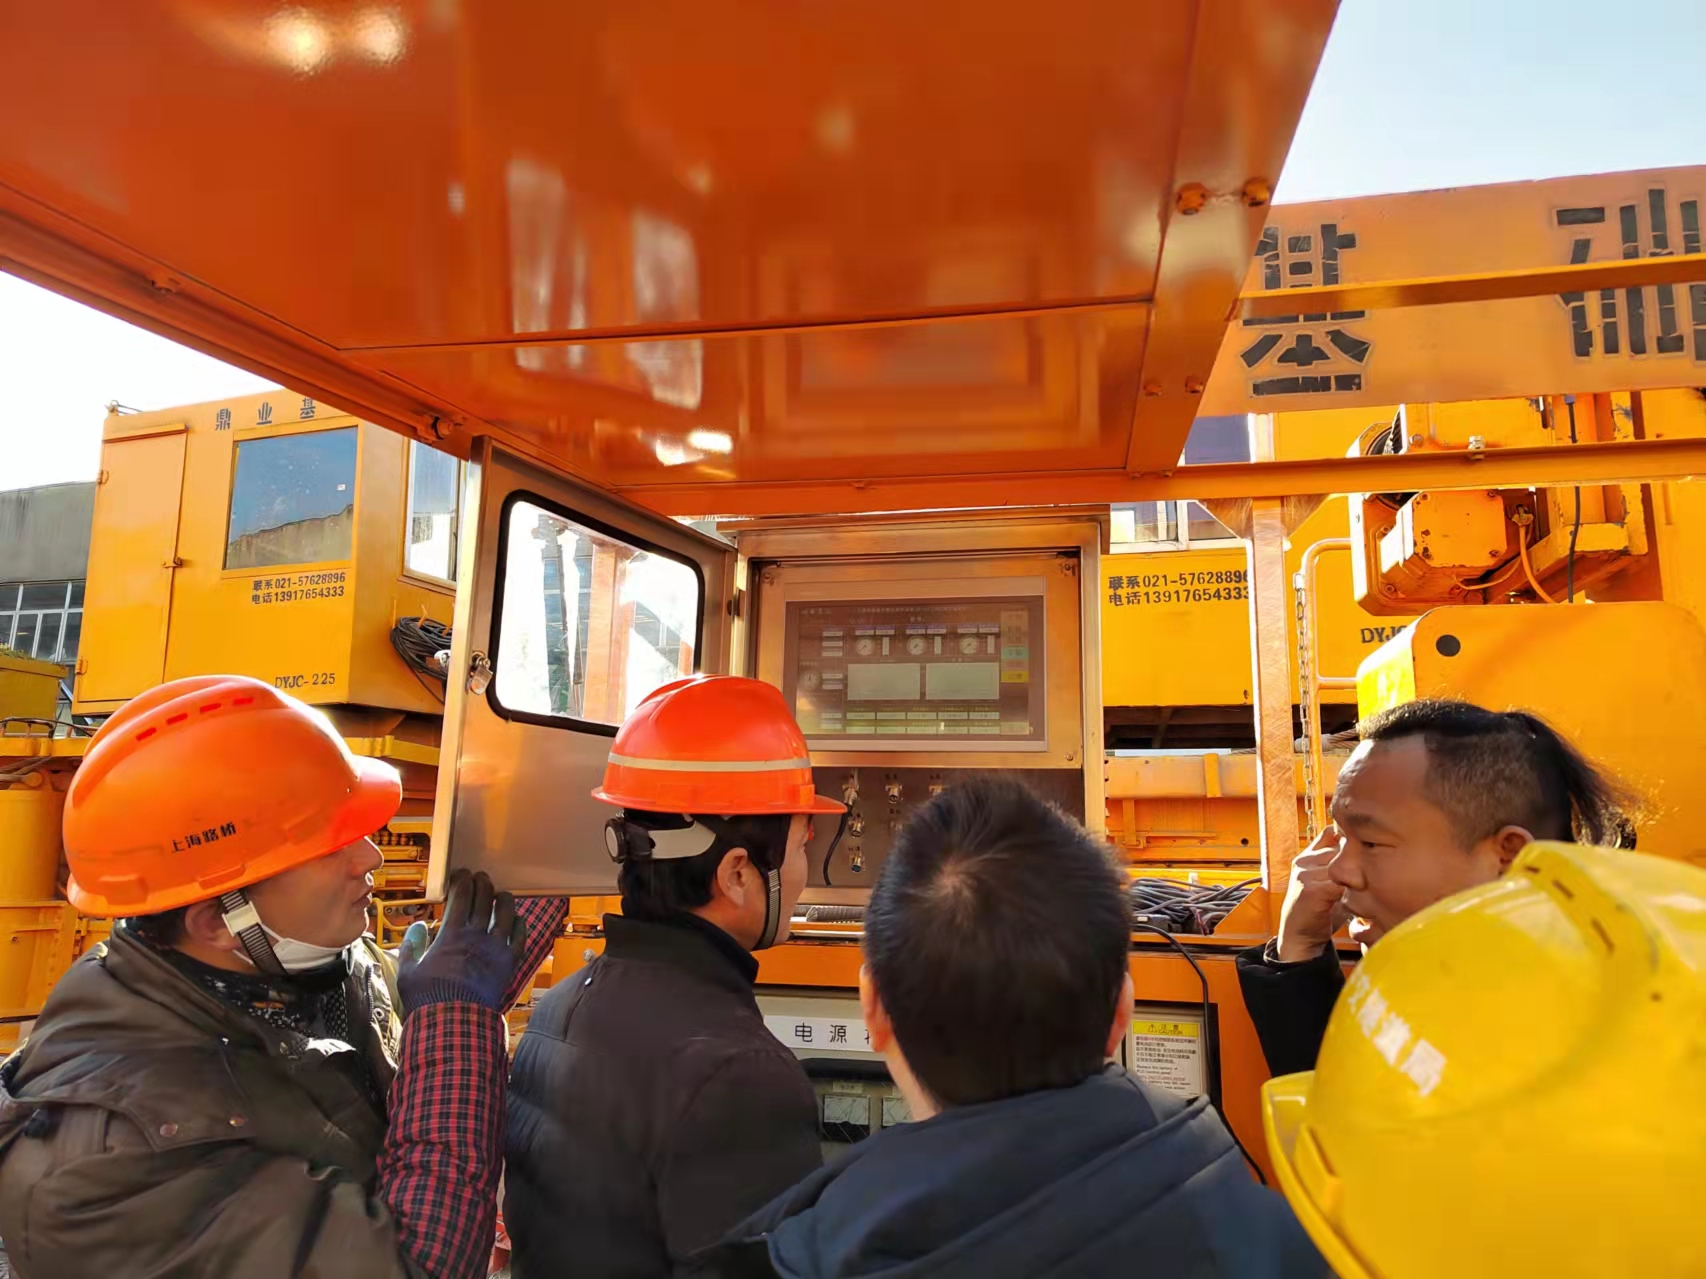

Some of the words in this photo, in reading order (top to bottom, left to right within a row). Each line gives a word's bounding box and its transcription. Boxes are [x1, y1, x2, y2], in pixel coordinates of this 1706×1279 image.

[215, 397, 316, 431] 鼎业基
[253, 572, 346, 592] 联系021-57628896
[252, 585, 345, 605] 电话13917654333
